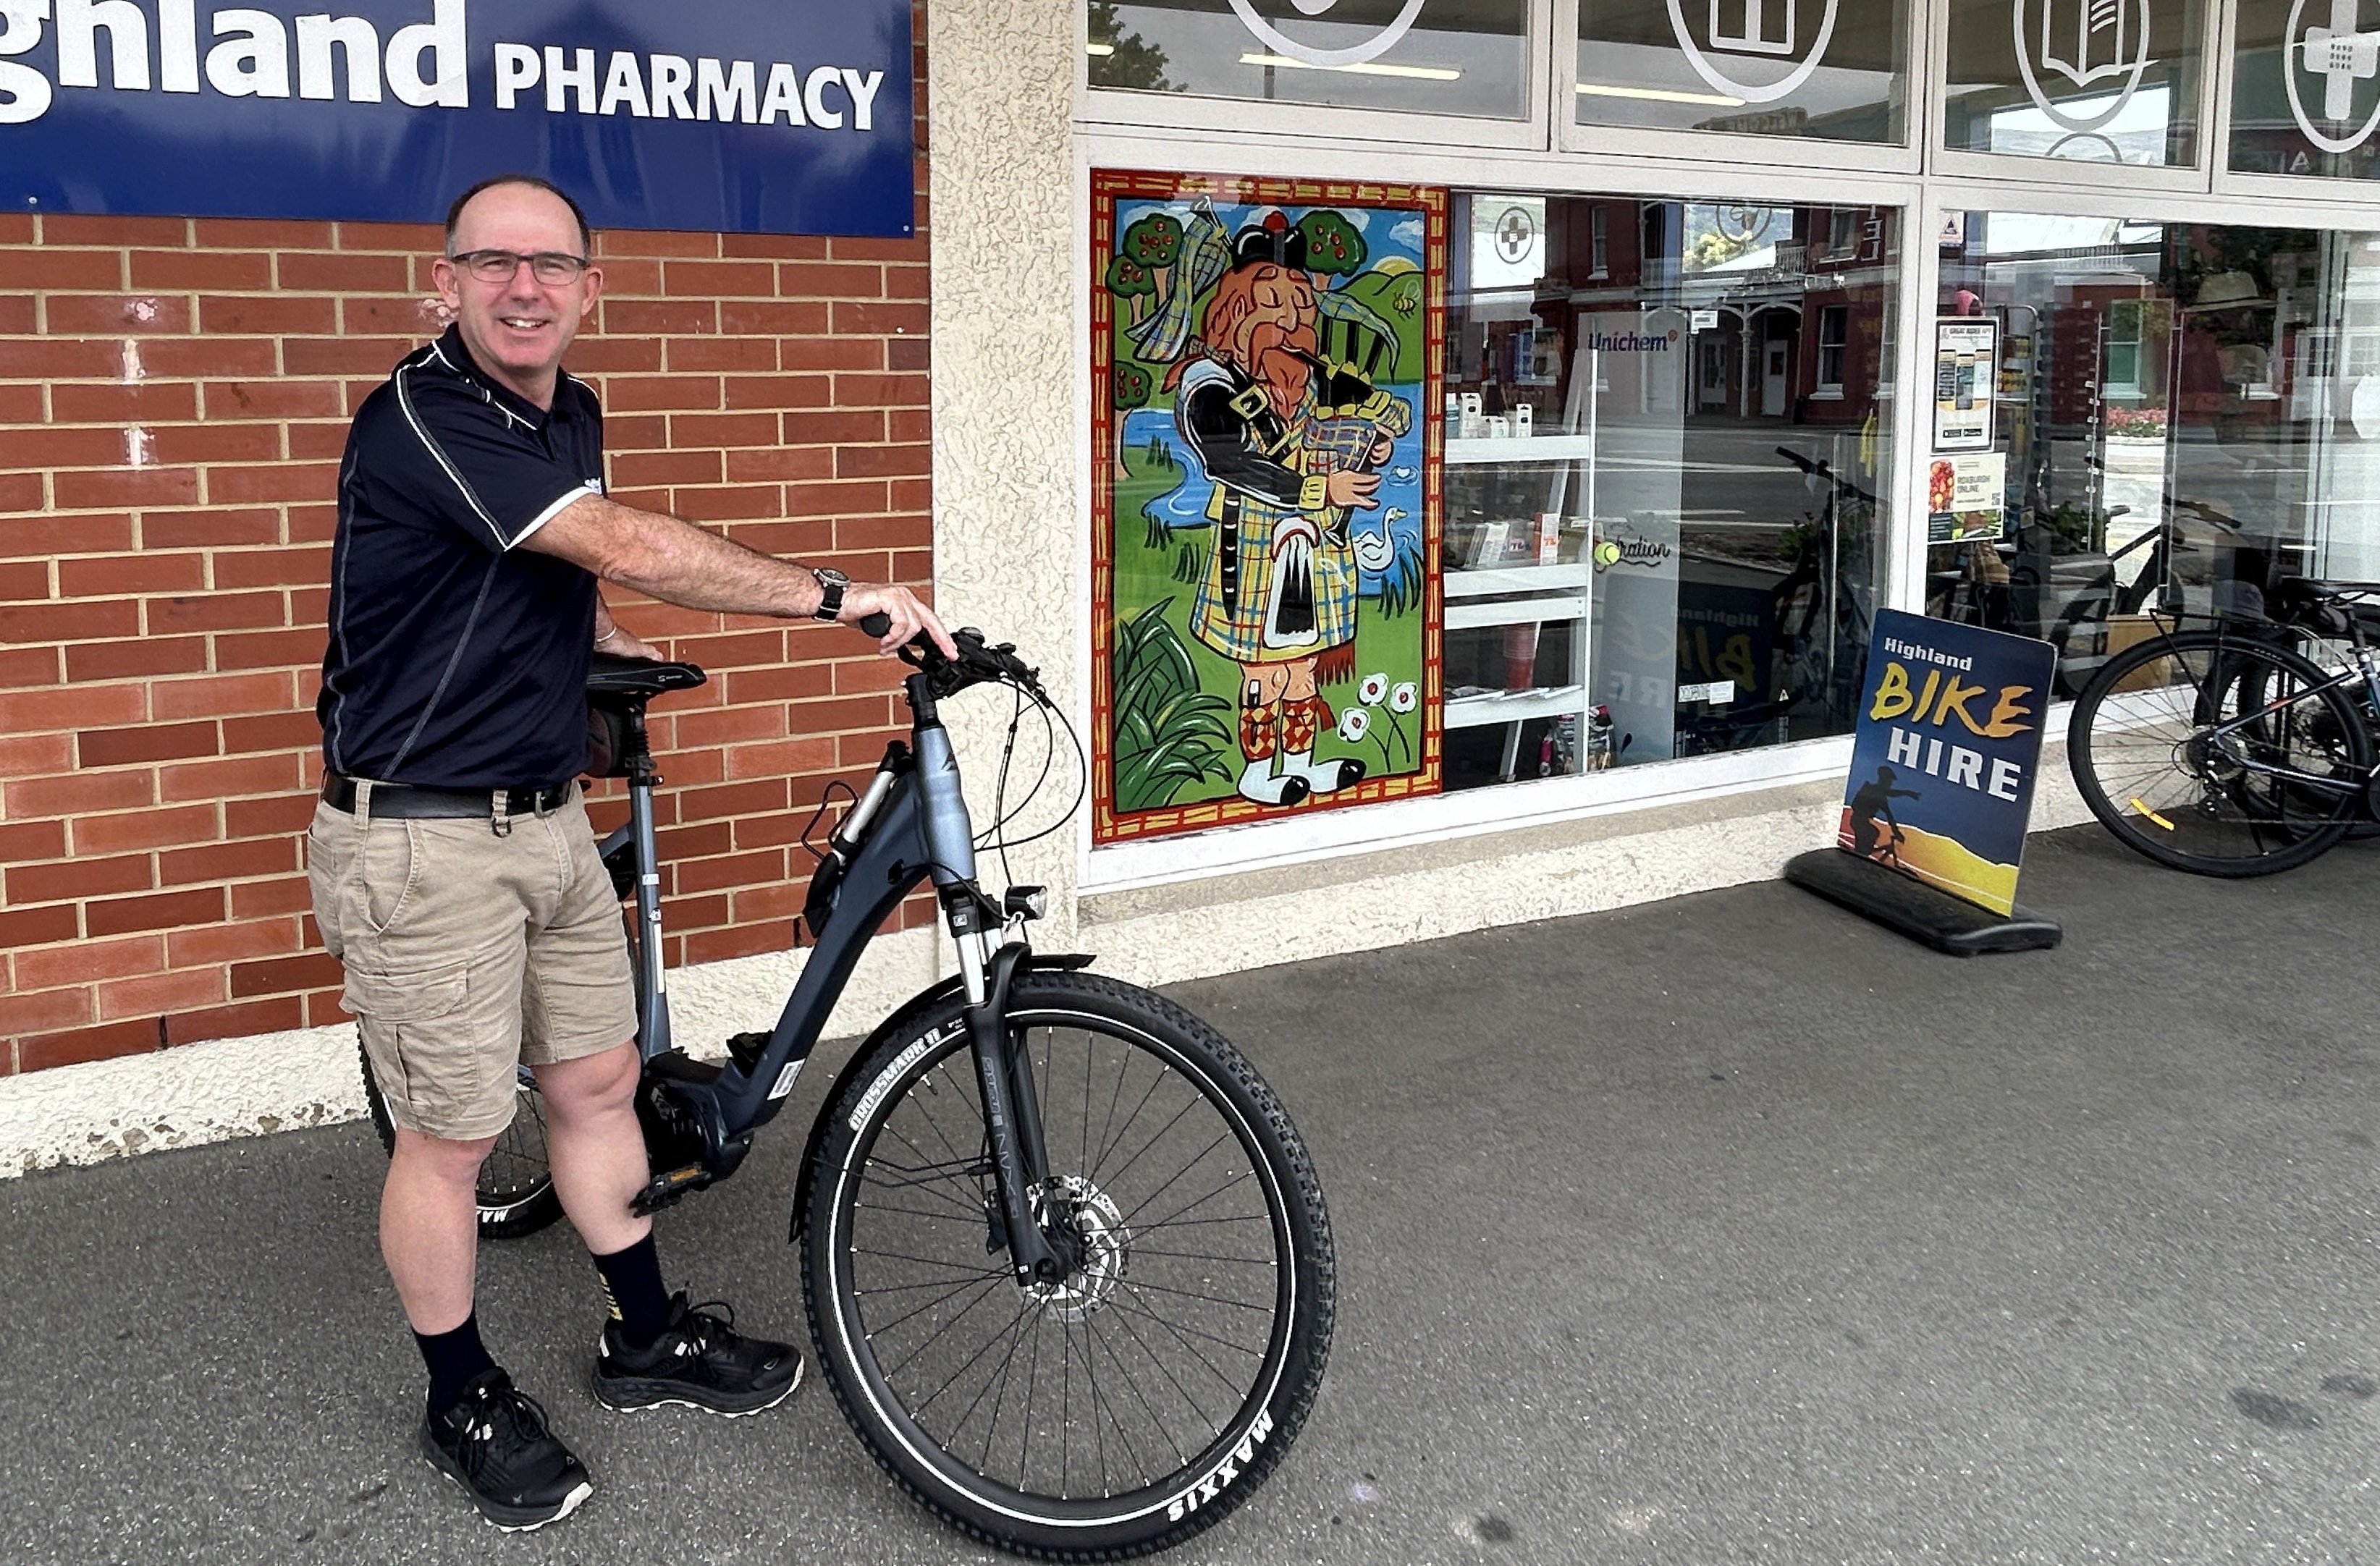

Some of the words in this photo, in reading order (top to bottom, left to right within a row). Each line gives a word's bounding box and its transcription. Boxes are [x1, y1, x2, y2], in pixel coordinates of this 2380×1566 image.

[495, 42, 884, 132] PHARMACY
[1587, 331, 1668, 352] Unichem
[1883, 637, 1973, 672] Highland
[1870, 662, 2035, 738] BIKE
[1886, 726, 2022, 803] HIRE
[1167, 1409, 1275, 1522] MAXXIS
